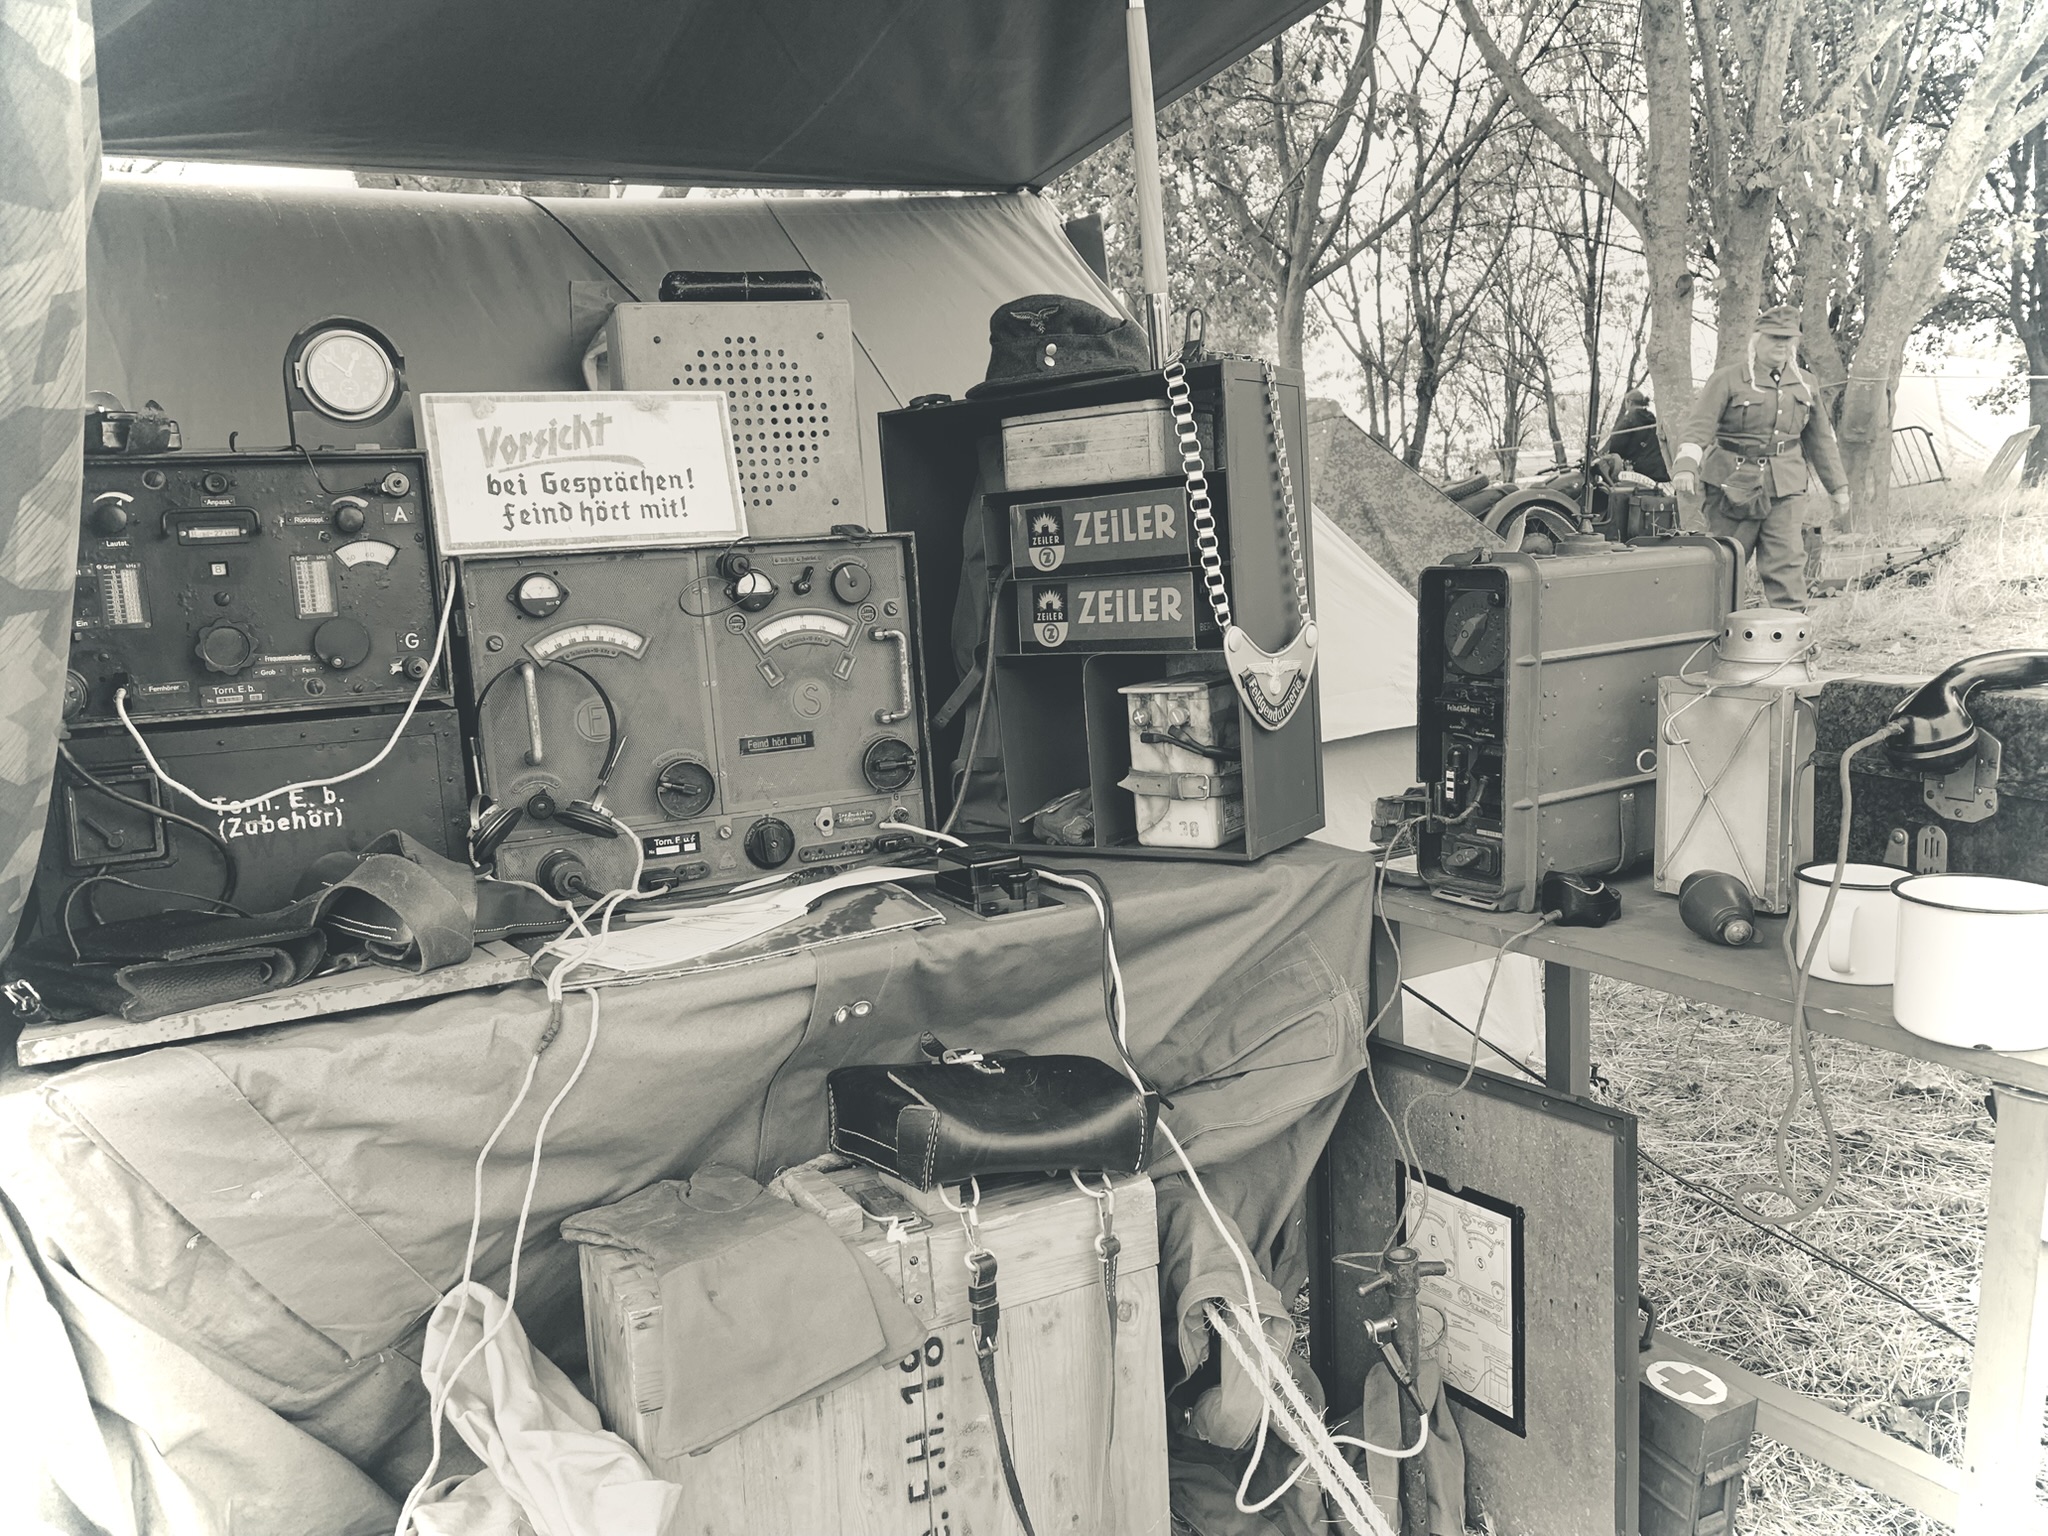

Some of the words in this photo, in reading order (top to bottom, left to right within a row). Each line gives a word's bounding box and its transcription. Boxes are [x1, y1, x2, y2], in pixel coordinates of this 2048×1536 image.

[477, 412, 613, 468] Vorsicht
[486, 473, 527, 496] bei
[540, 467, 695, 499] Gesprächen!
[393, 505, 408, 522] A
[580, 500, 631, 526] hört
[640, 496, 689, 519] mit!
[106, 540, 130, 548] Lautst.
[76, 619, 89, 627] Ein
[404, 632, 420, 649] G
[260, 668, 277, 676] Grob
[802, 683, 821, 716] S
[747, 738, 769, 749] Feind
[771, 737, 788, 748] hört
[217, 805, 344, 844] (Zubehör)
